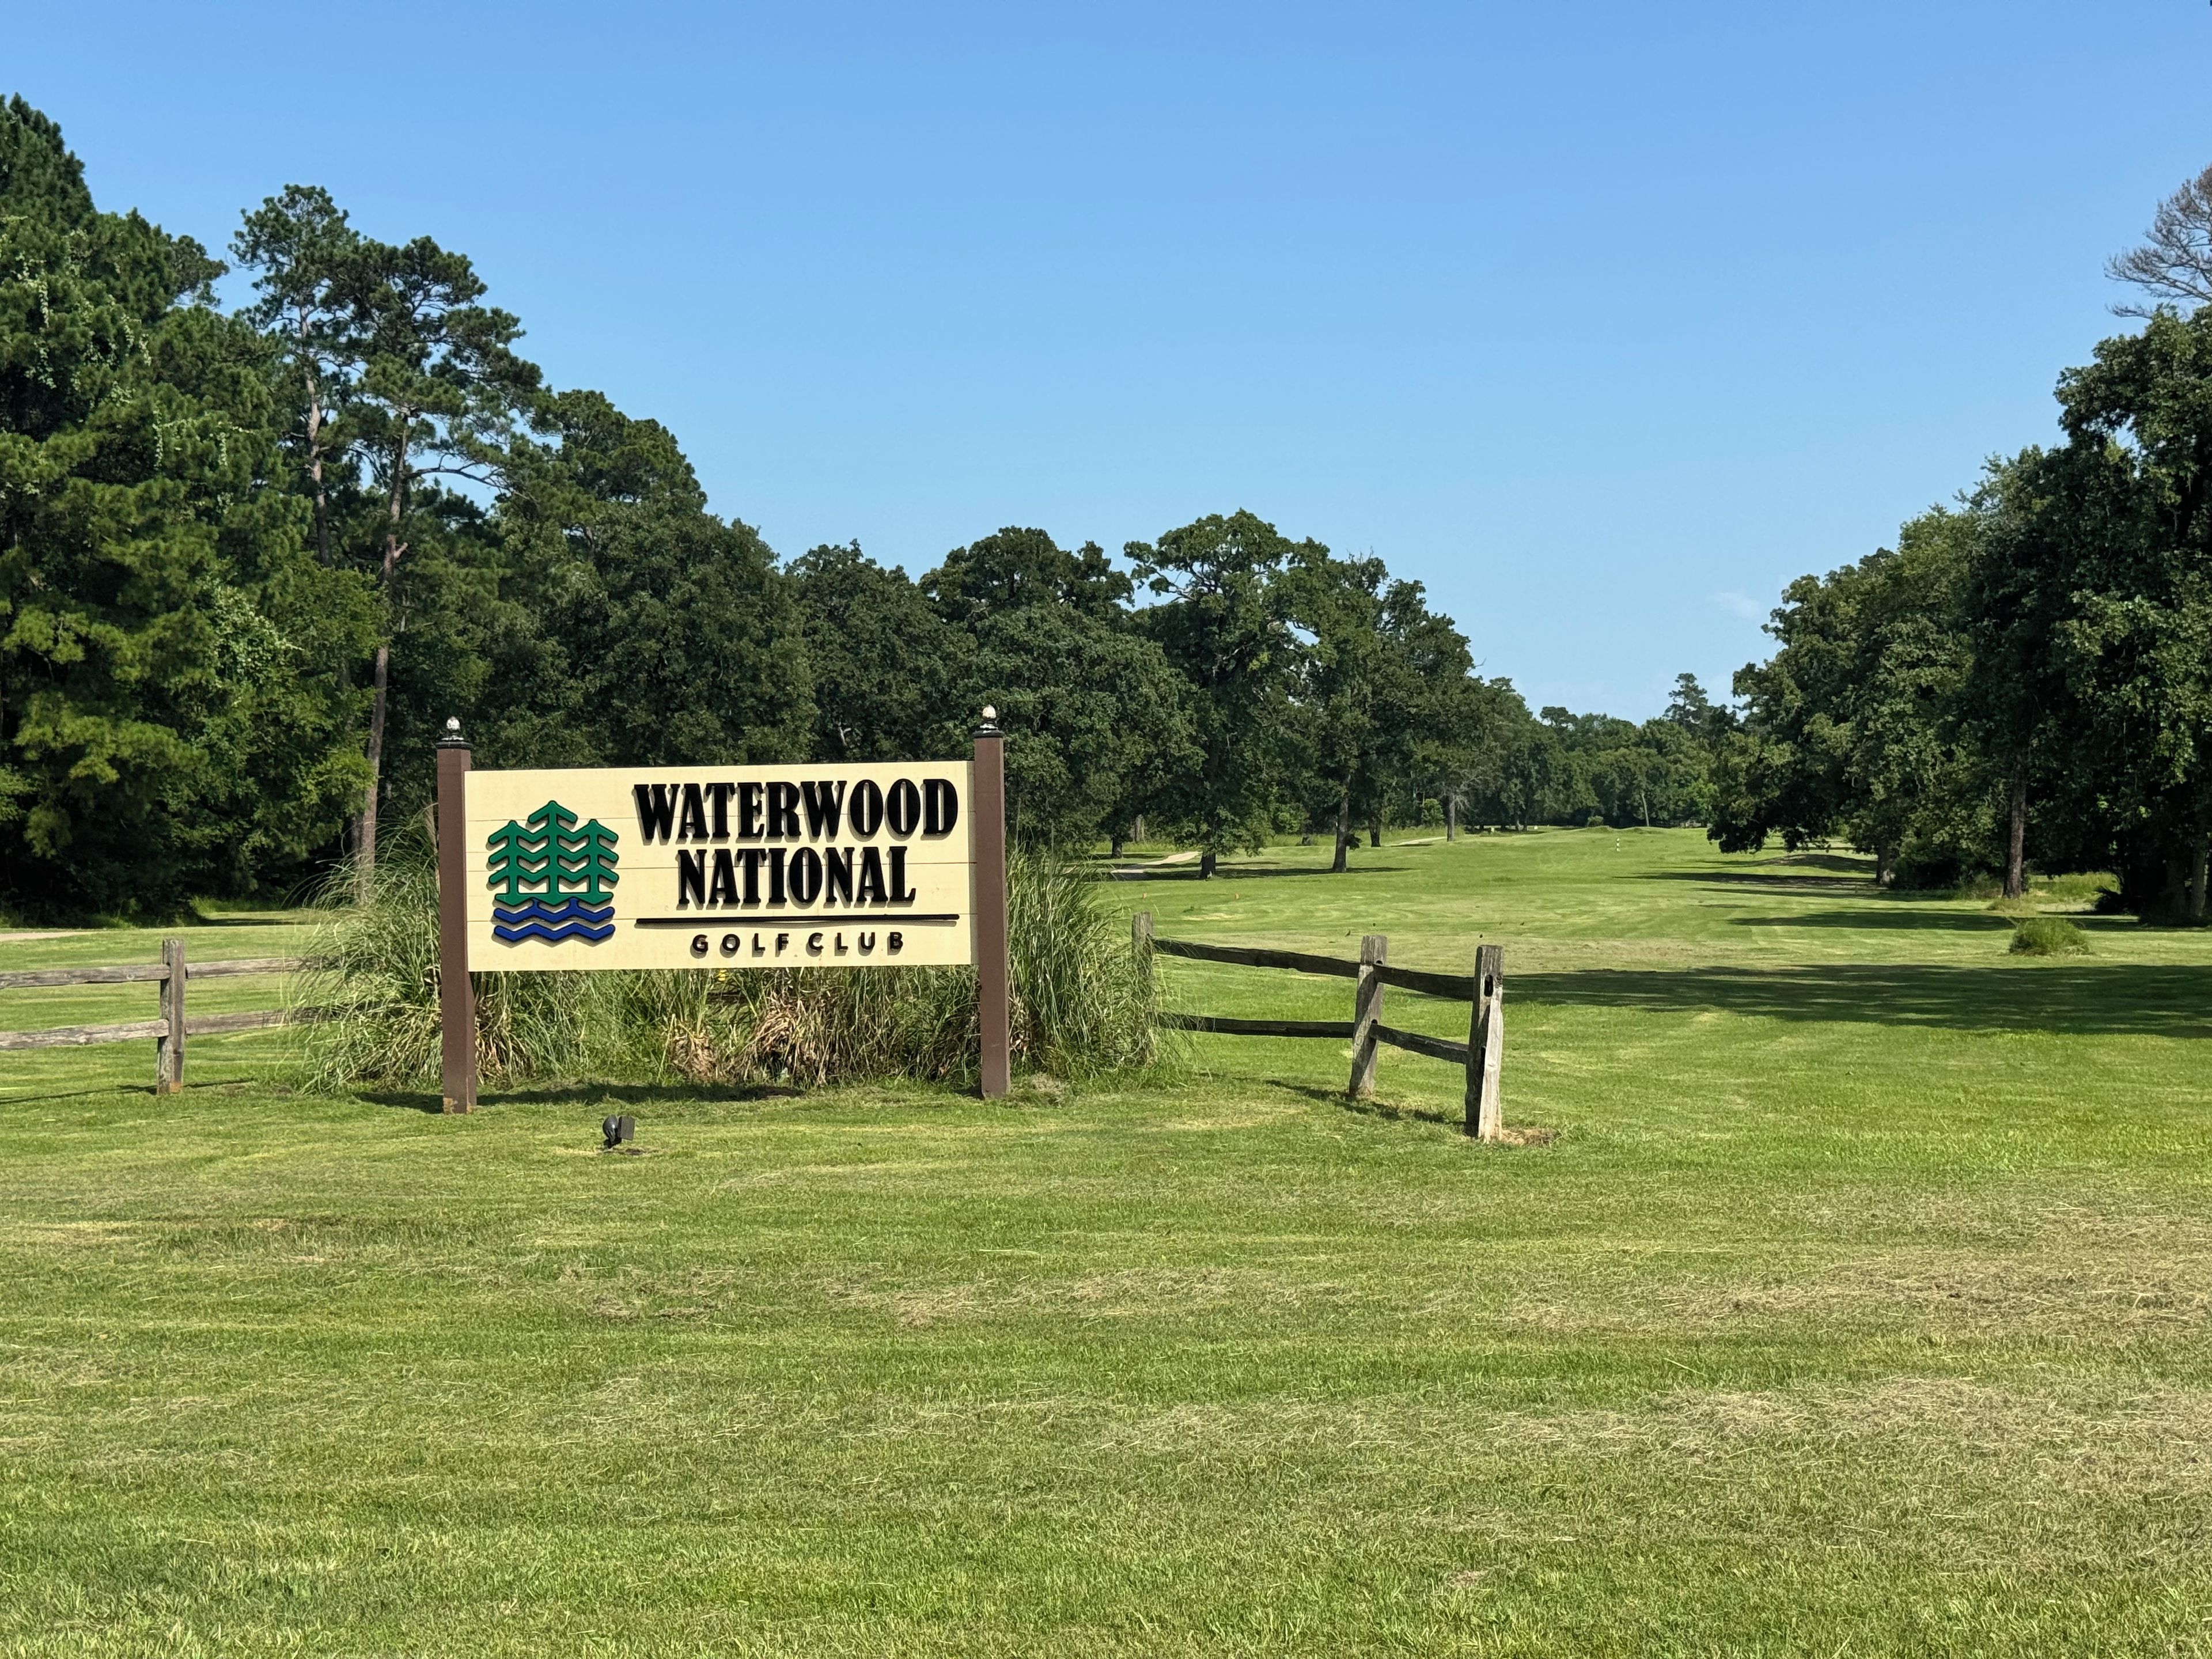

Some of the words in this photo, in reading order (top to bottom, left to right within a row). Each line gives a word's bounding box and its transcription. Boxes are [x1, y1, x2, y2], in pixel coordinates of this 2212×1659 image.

[633, 778, 959, 840] WATERWOOD
[677, 846, 916, 906] NATIONAL
[691, 933, 790, 953] GOLF
[807, 931, 904, 952] CLUB
